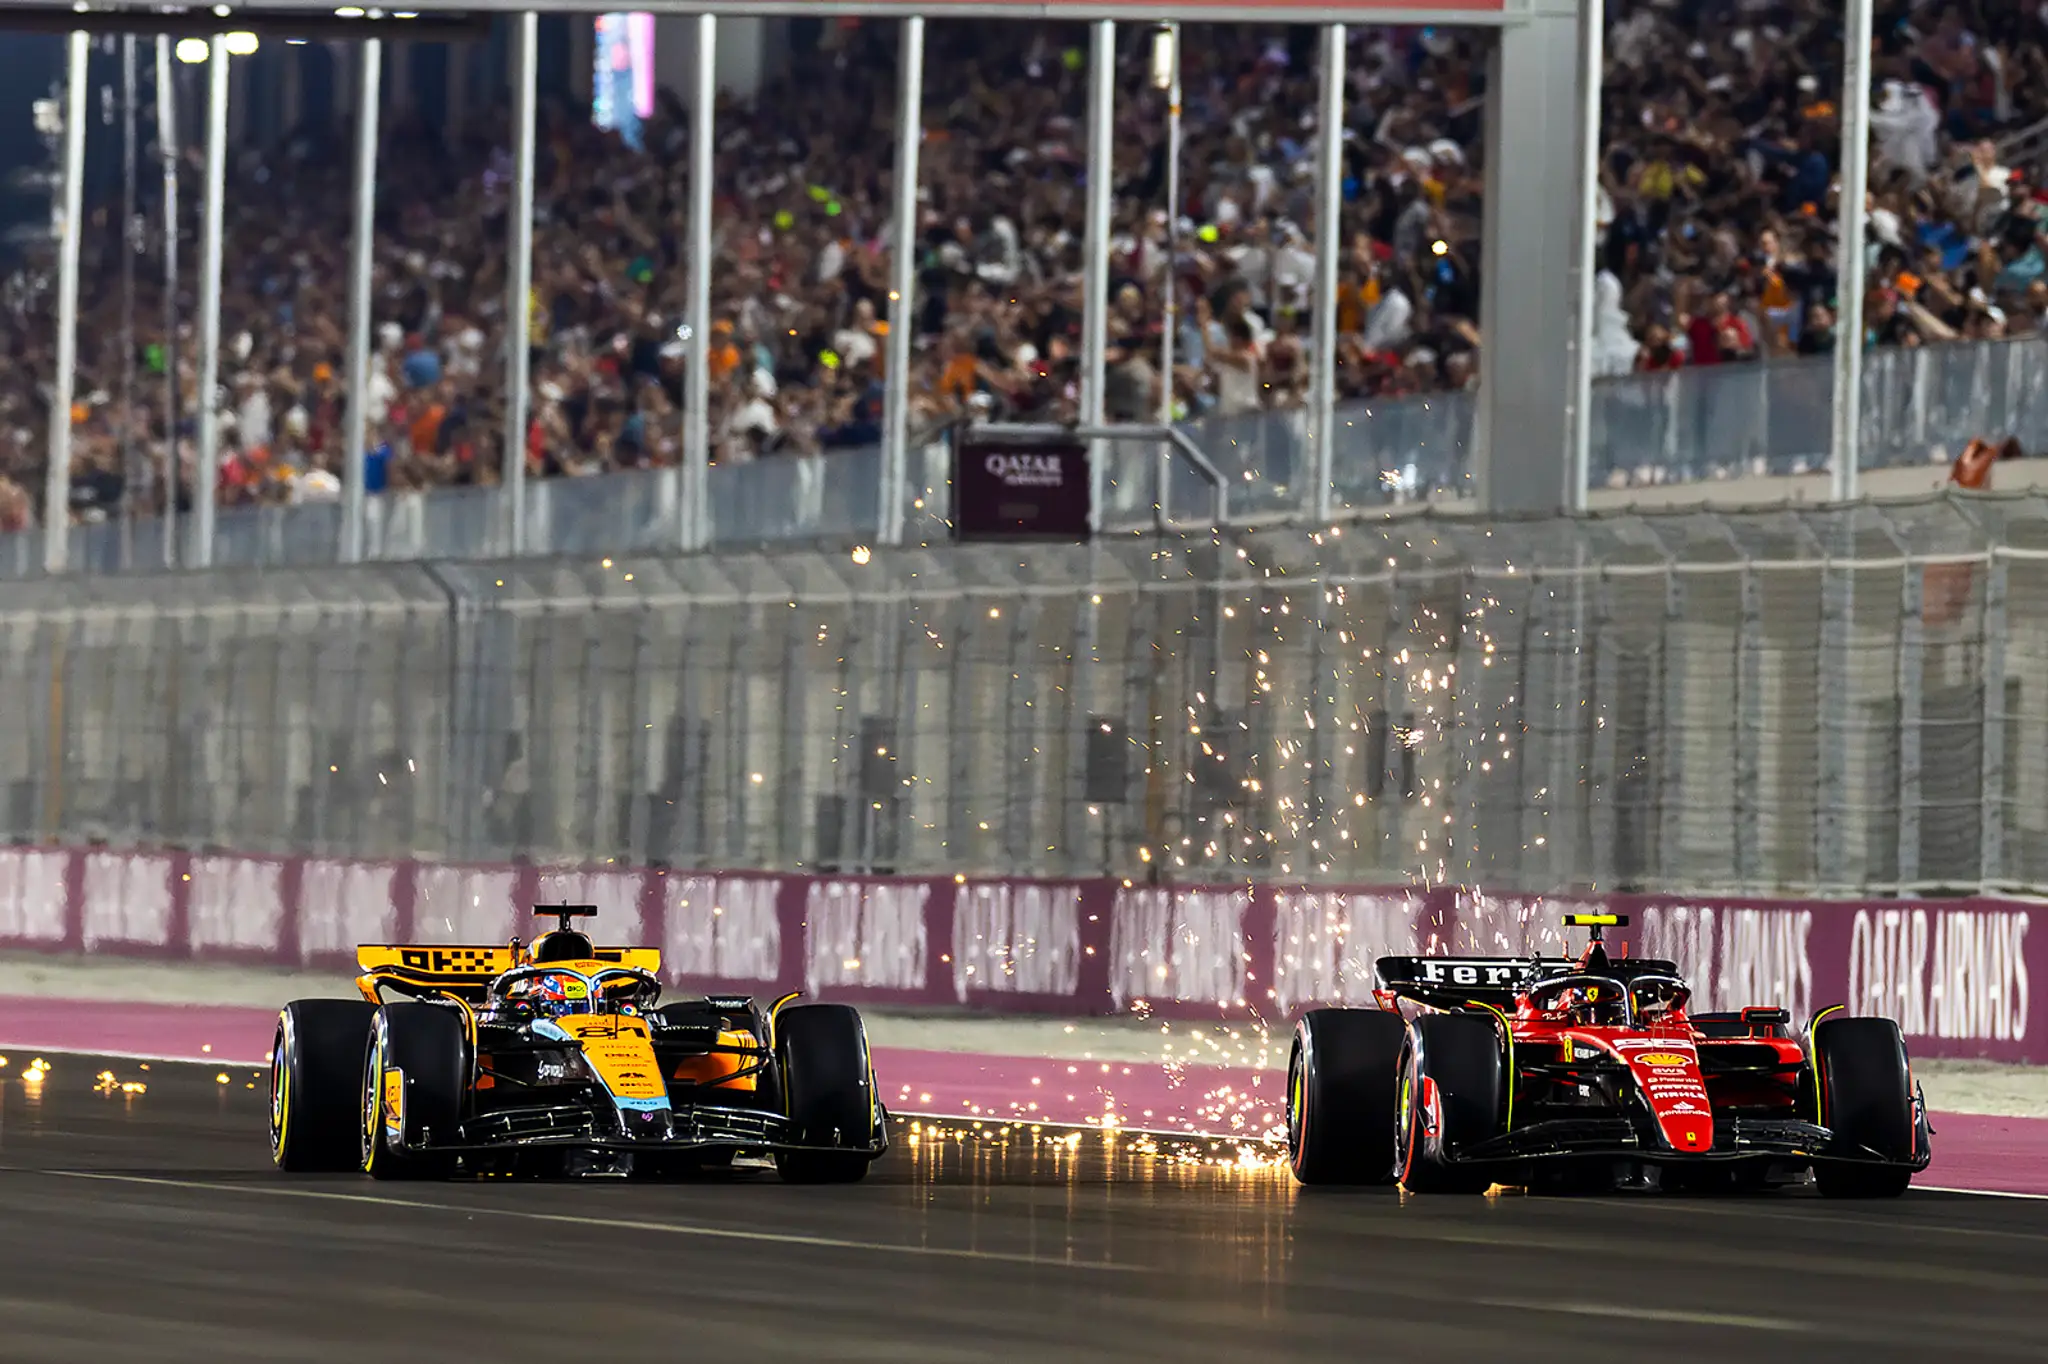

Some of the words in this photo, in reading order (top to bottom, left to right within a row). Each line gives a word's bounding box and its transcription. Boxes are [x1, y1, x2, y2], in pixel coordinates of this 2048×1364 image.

[985, 453, 1062, 476] QATAR
[1848, 908, 1927, 1036] QATAR
[1928, 909, 2029, 1042] AIRWAYS
[576, 1026, 647, 1039] 81
[1612, 1038, 1696, 1051] 55
